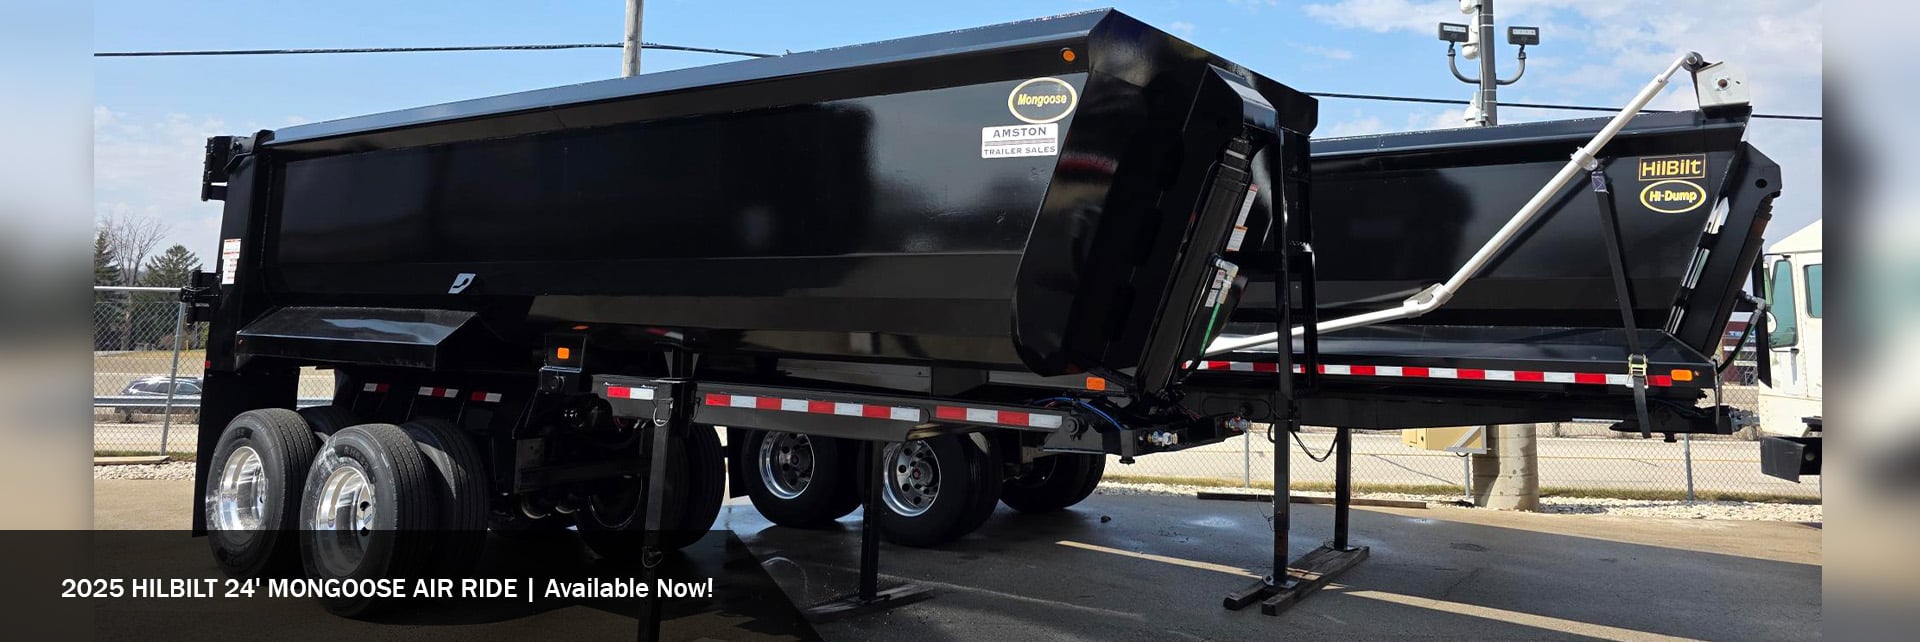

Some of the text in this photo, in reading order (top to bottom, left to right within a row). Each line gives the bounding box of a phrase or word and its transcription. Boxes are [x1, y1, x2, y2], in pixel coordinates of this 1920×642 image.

[1017, 93, 1067, 107] Mongoose
[993, 127, 1047, 138] AMSTON
[984, 146, 1056, 156] TRAILER SALES
[1642, 159, 1701, 176] HilBilt
